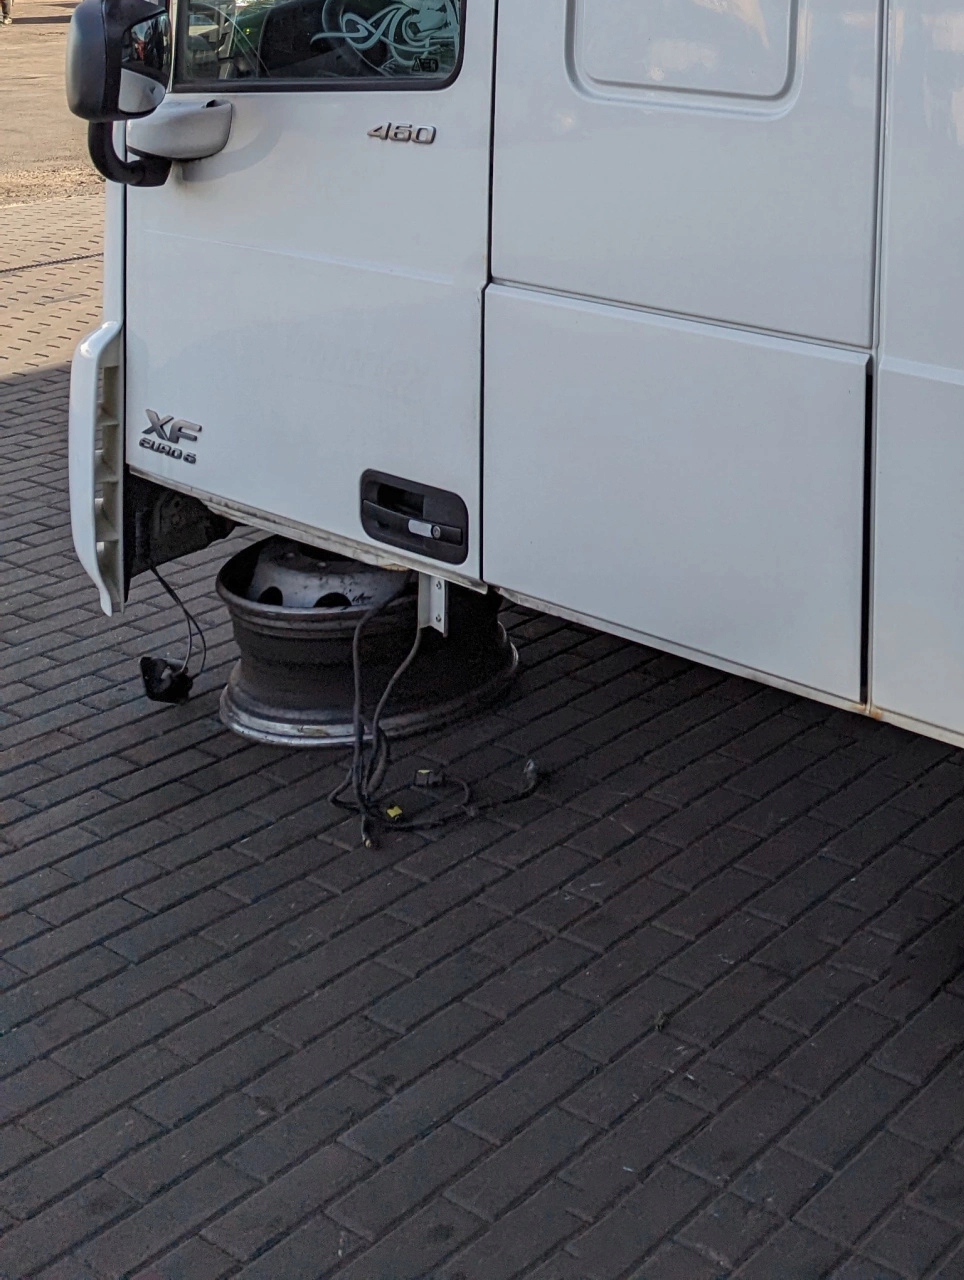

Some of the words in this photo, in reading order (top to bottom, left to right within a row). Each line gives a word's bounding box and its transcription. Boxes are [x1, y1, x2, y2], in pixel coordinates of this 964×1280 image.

[366, 122, 437, 145] 460
[142, 408, 203, 444] XF
[138, 437, 183, 460] EURO
[182, 451, 197, 464] 6
